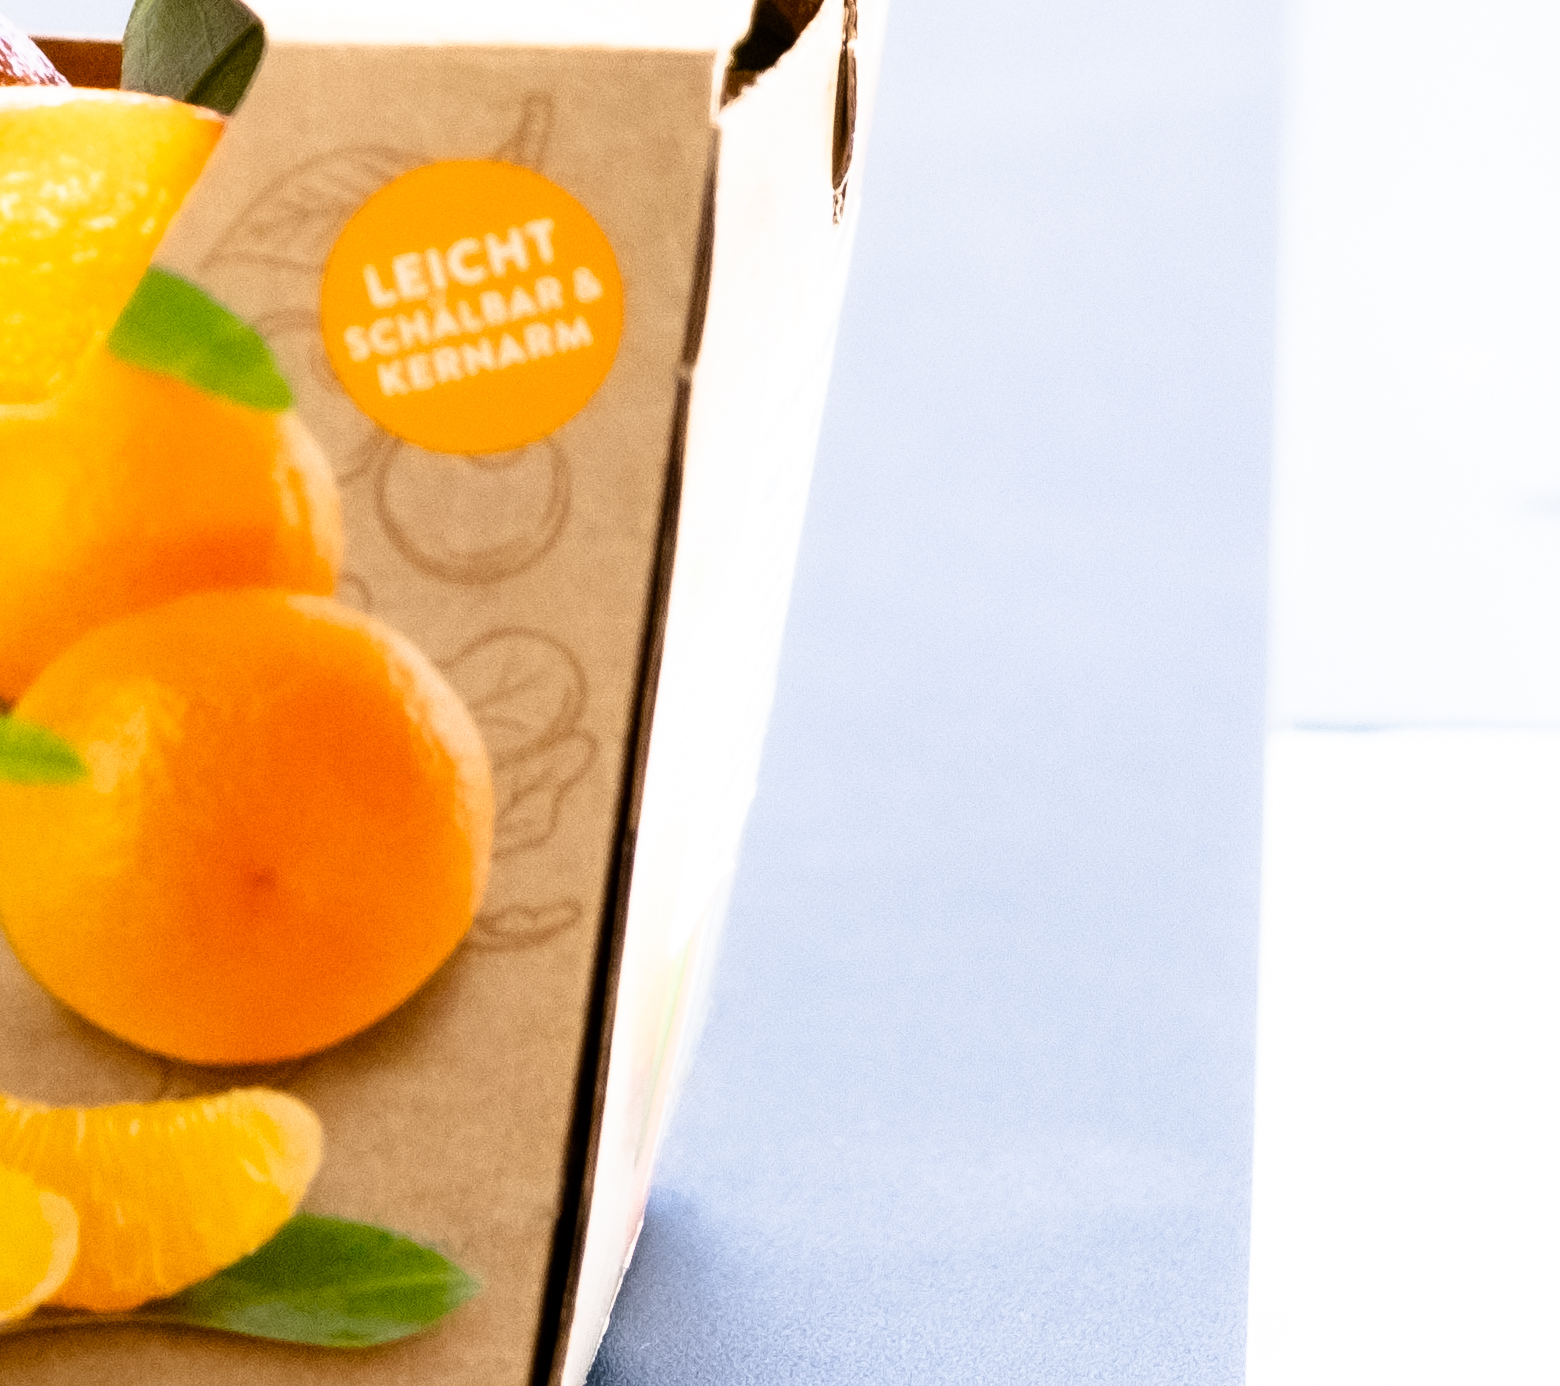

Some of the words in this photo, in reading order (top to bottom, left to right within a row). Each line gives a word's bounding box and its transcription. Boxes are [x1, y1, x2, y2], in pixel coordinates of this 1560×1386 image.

[362, 216, 556, 310] LEICHT
[342, 275, 564, 363] SCHÄLBAR
[375, 315, 595, 397] KERNARM
